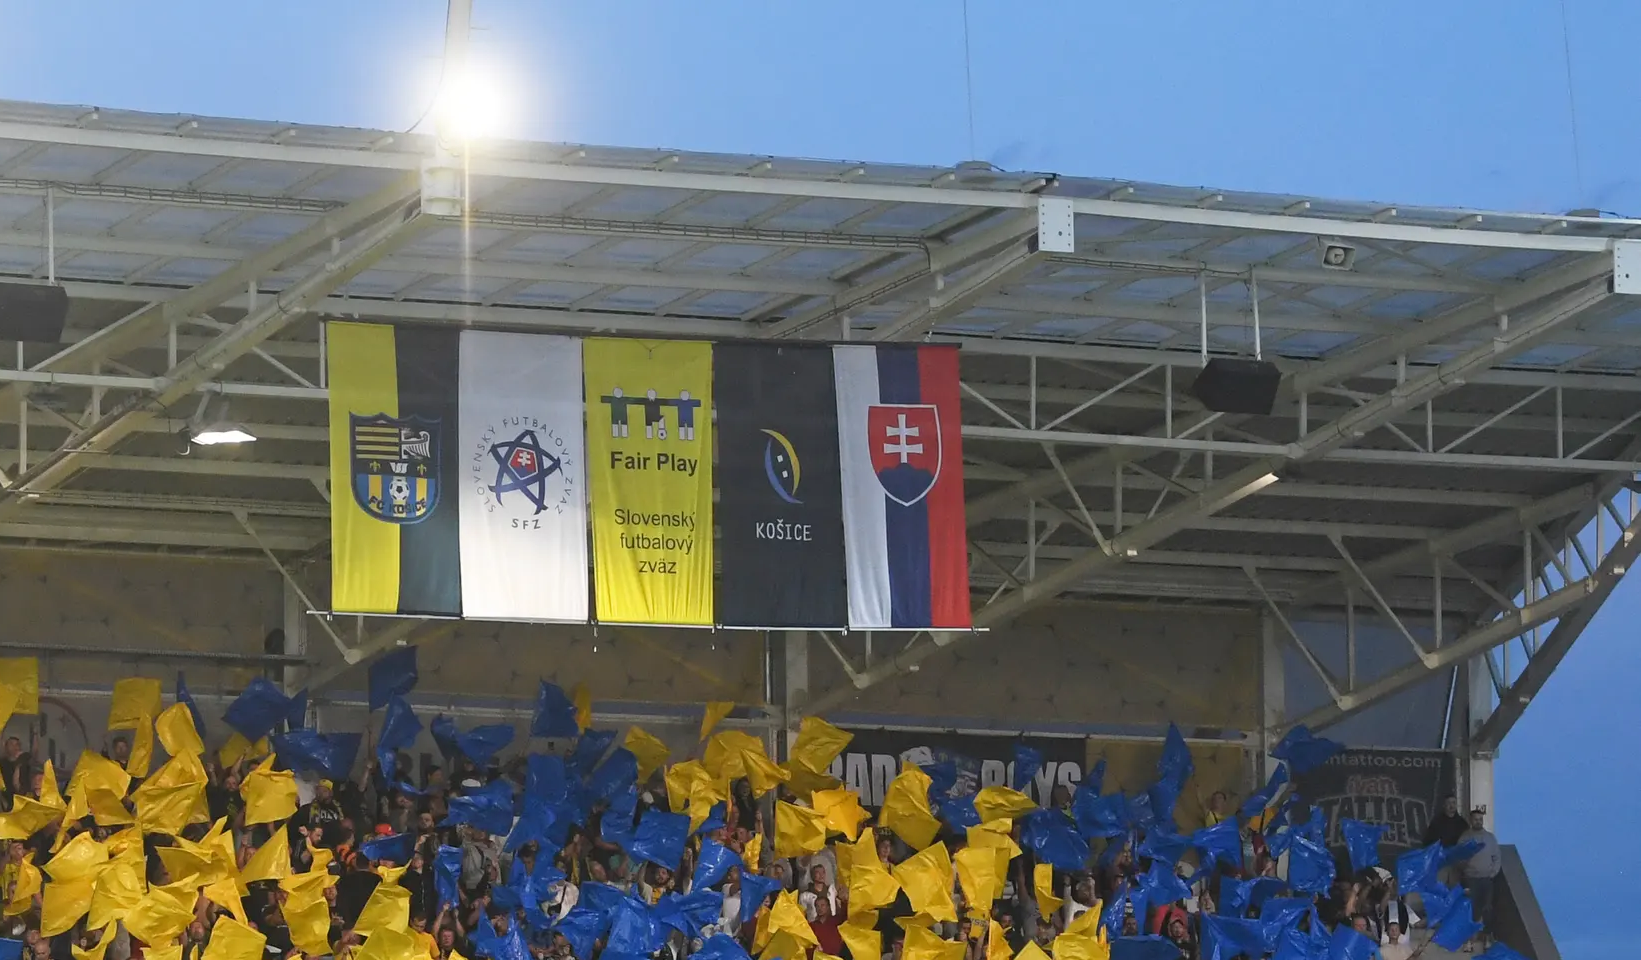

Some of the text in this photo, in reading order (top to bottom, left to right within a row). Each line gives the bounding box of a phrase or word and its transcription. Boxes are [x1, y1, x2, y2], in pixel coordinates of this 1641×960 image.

[610, 451, 698, 477] Fair Play
[511, 518, 542, 530] SFZ
[614, 508, 696, 532] Slovenský
[755, 518, 812, 541] KOŠICE
[620, 533, 694, 555] futbalový
[638, 558, 677, 574] zväz
